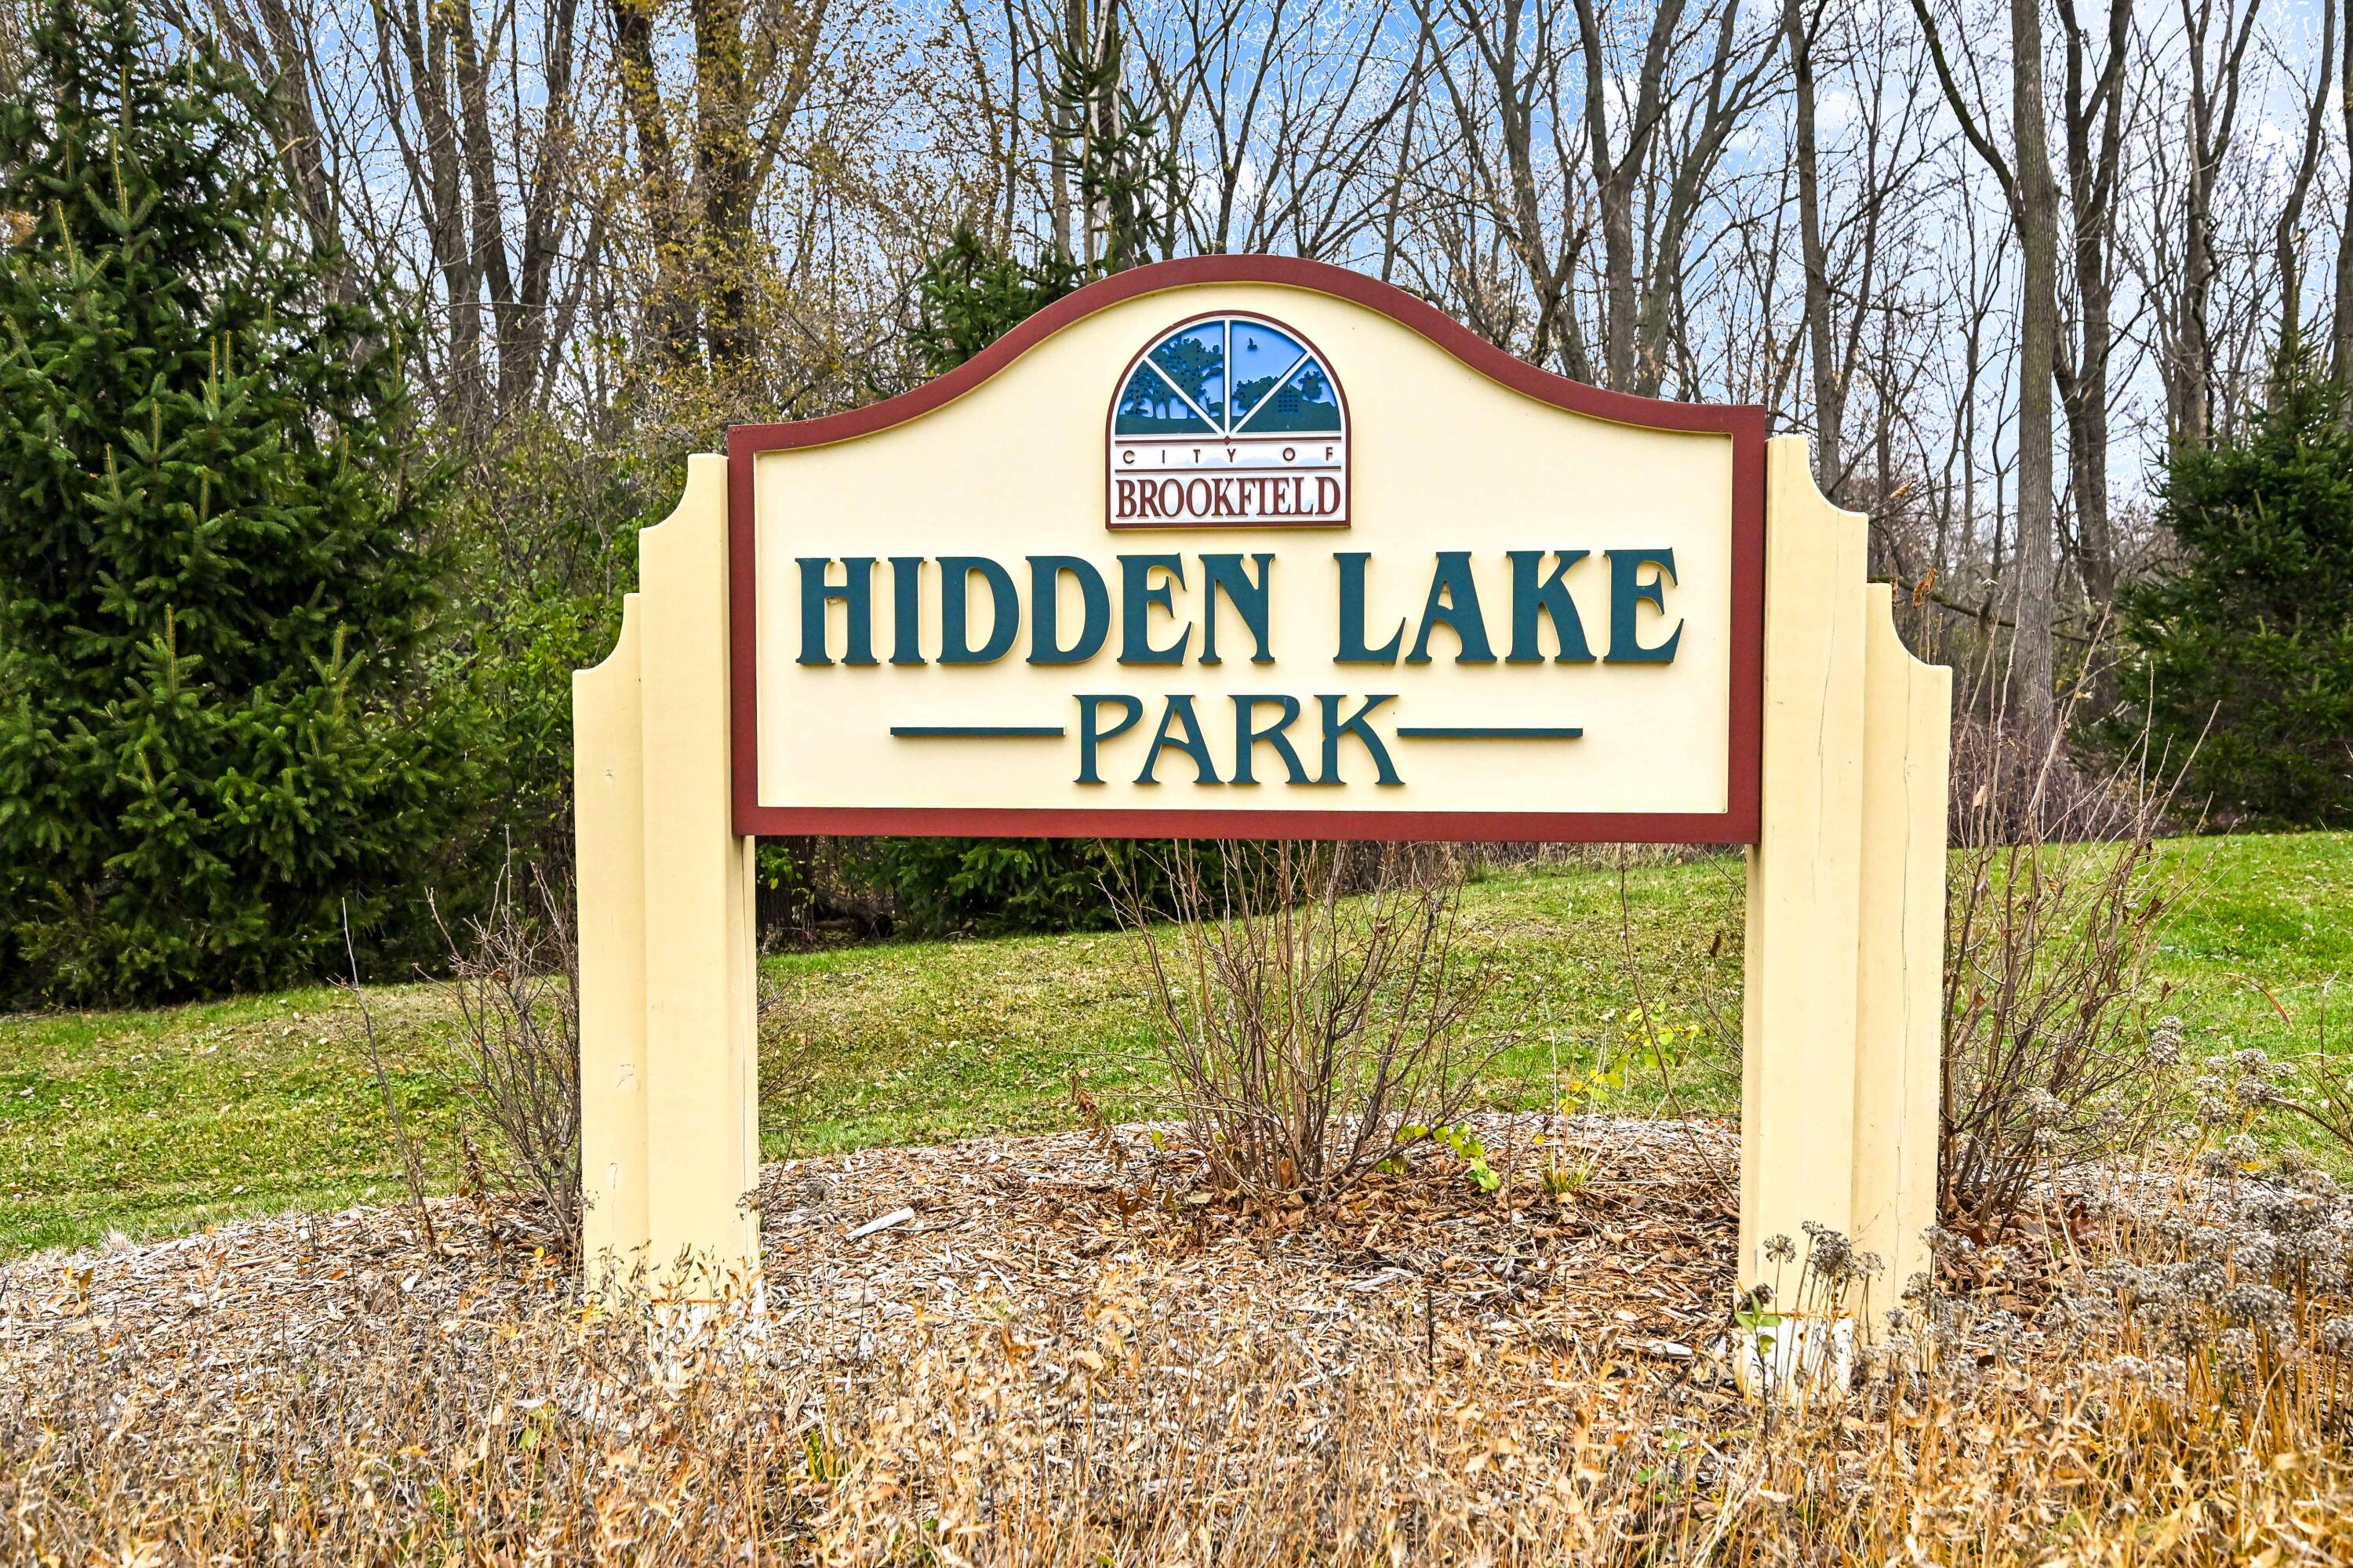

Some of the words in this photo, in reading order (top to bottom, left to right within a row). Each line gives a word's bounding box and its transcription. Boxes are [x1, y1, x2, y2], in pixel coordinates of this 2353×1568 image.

[1122, 448, 1237, 464] CITY
[1282, 447, 1333, 462] OF
[1115, 476, 1341, 518] BROOKFIELD
[795, 552, 1276, 665] HIDDEN
[1333, 548, 1685, 664] LAKE
[1072, 694, 1406, 785] PARK
